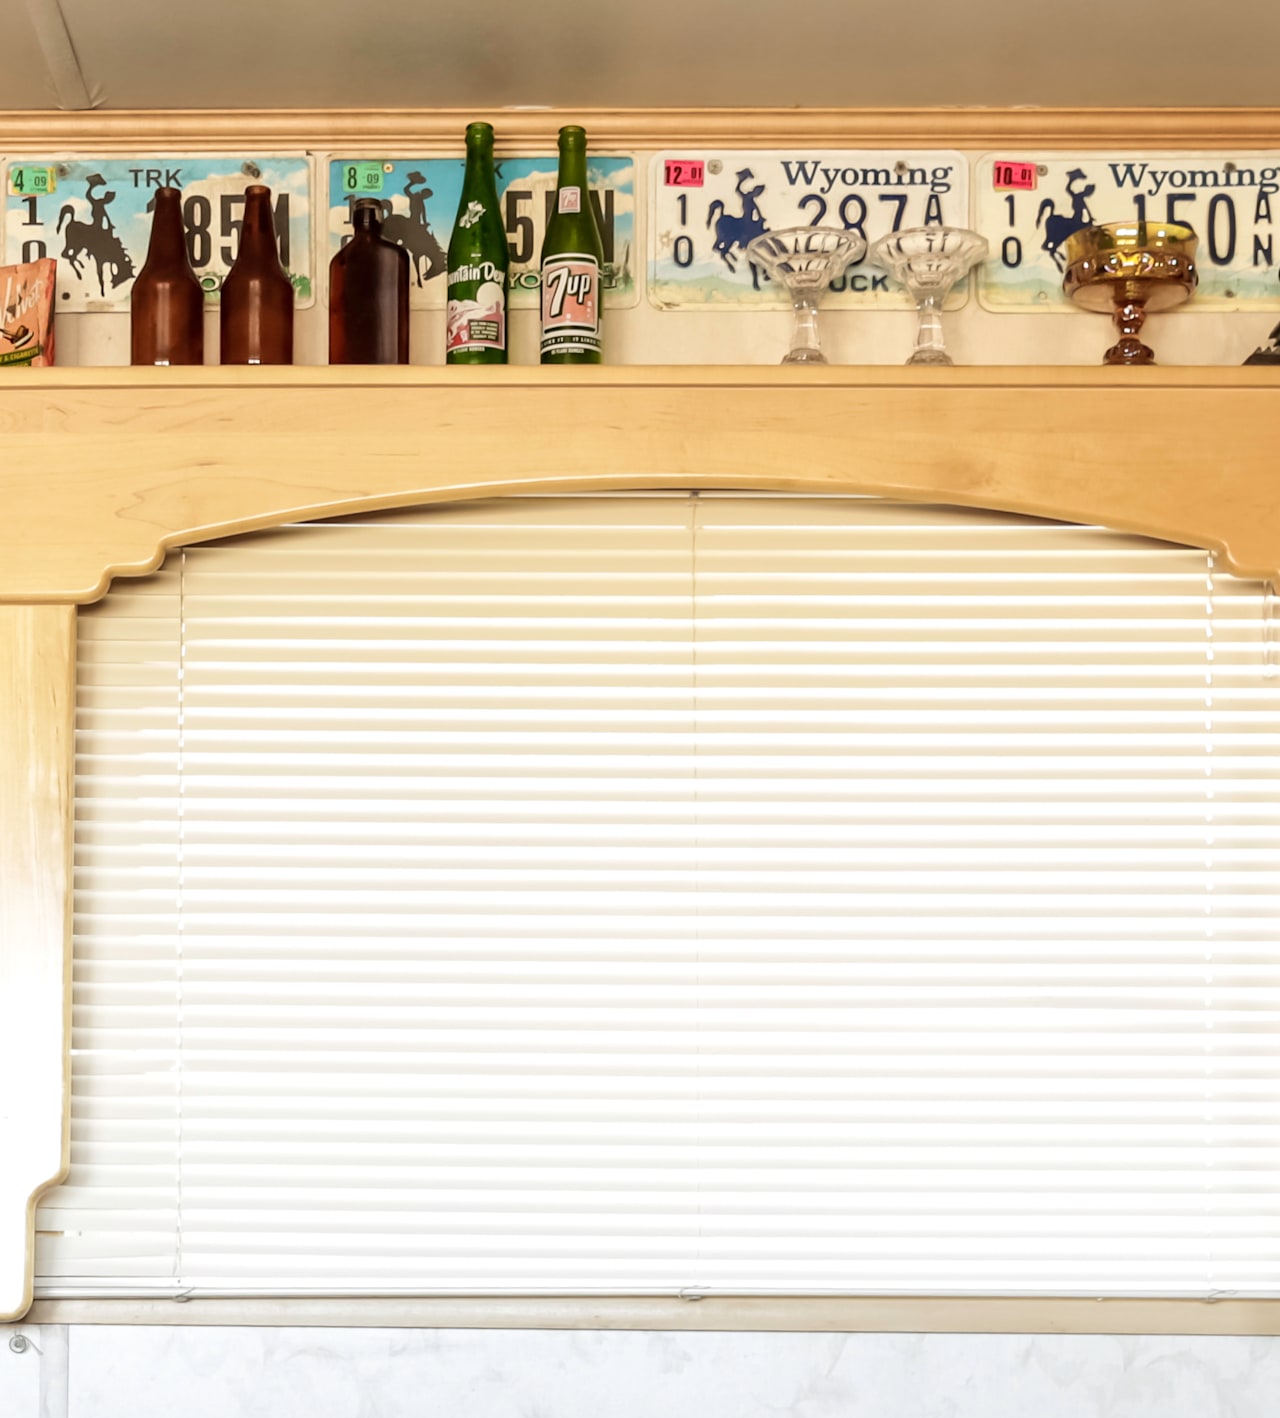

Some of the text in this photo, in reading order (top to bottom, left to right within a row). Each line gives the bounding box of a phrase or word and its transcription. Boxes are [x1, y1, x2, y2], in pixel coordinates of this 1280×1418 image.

[13, 169, 24, 192] 4
[128, 169, 183, 188] TRK
[347, 166, 358, 190] 8
[781, 160, 953, 193] Wyoming
